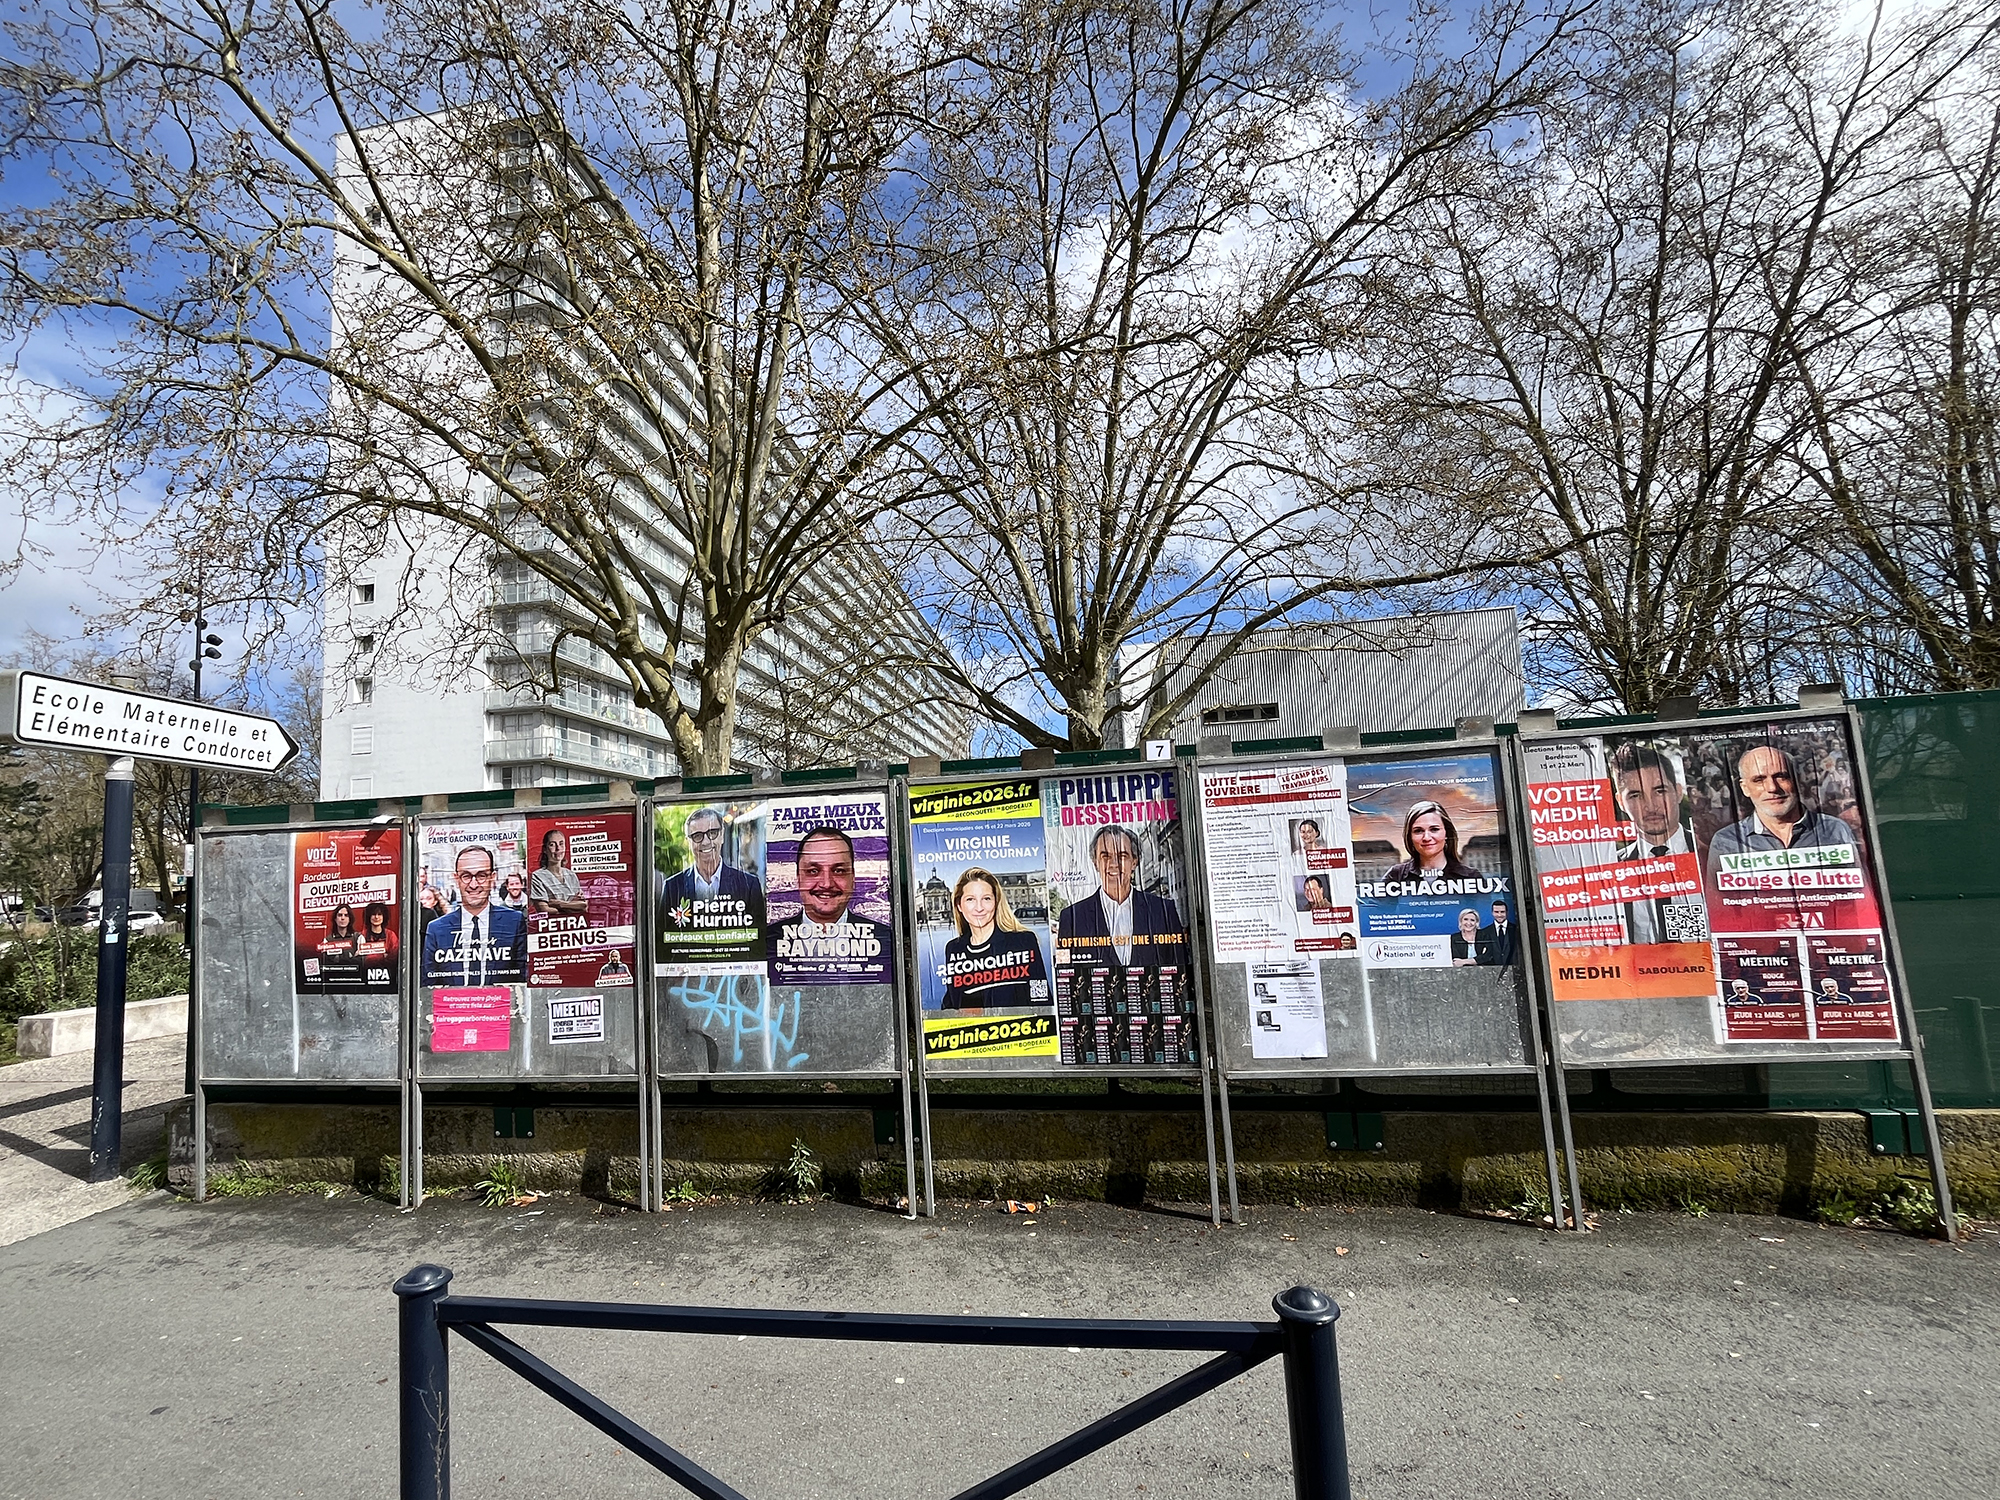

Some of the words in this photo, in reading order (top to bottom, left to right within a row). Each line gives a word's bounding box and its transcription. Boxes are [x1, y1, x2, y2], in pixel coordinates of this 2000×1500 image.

[32, 685, 104, 714] Ecole
[123, 702, 237, 737] Maternelle
[251, 727, 267, 742] et
[31, 711, 170, 749] Elémentaire
[183, 736, 272, 763] Condorcet
[1694, 734, 1727, 742] ÉLECTIONS
[1155, 745, 1164, 757] 7
[1204, 776, 1236, 788] LUTTE
[1290, 772, 1310, 780] CAMP
[1311, 768, 1324, 776] DES
[1060, 772, 1175, 806] PHILIPPE
[1204, 784, 1260, 797] OUVRIÈRE
[1281, 776, 1329, 791] TRAVAILLEURS
[1528, 784, 1602, 805] VOTEZ
[912, 783, 1032, 814] virginie2026.fr
[1308, 791, 1341, 799] BORDEAUX
[772, 806, 821, 821] FAIRE
[824, 802, 881, 818] MIEUX
[1001, 802, 1033, 812] BORDEAUX
[1061, 799, 1180, 827] DESSERTINE
[1532, 806, 1598, 824] MEDHI
[792, 816, 885, 834] BORDEAUX
[946, 825, 974, 833] municipales
[1533, 822, 1637, 843] Saboulard
[428, 836, 448, 844] FAIRE
[450, 834, 478, 843] GAGNER
[479, 832, 518, 841] BORDEAUX
[572, 834, 606, 842] ARRACHER
[944, 835, 1011, 850] VIRGINIE
[307, 846, 337, 860] VOTEZ
[572, 844, 620, 854] BORDEAUX
[918, 850, 982, 864] BONTHOUX
[984, 846, 1040, 859] TOURNAY
[1308, 852, 1346, 861] QUANDALLE
[1723, 853, 1772, 870] Vert
[1776, 851, 1800, 865] de
[1805, 848, 1850, 865] rage
[303, 872, 340, 882] Bordeaux
[1419, 868, 1444, 878] Julie
[1542, 873, 1582, 888] Pour
[1584, 870, 1613, 882] une
[1615, 860, 1676, 882] gauche
[1720, 872, 1783, 891] Rouge
[1788, 872, 1812, 886] de
[1817, 871, 1861, 885] lutte
[310, 880, 360, 896] OUVRIÈRE
[1359, 877, 1510, 898] RECHAGNEUX
[1546, 894, 1564, 908] Ni
[1568, 892, 1591, 906] PS
[1601, 888, 1619, 901] Ni
[1620, 880, 1696, 898] Extrême
[305, 890, 388, 908] RÉVOLUTIONNAIRE
[692, 899, 746, 914] Pierre
[1723, 898, 1752, 906] Rouge
[1800, 892, 1865, 903] Anticapitaliste
[538, 916, 588, 932] PETRA
[694, 912, 754, 928] Hurmic
[1544, 914, 1625, 924] MEDHISABOULARD.FR
[665, 932, 703, 942] Bordeaux
[716, 930, 757, 940] confiance
[782, 922, 875, 940] NORDINE
[451, 931, 497, 948] Thomas
[538, 930, 608, 950] BERNUS
[1056, 936, 1111, 948] L'OPTIMISME
[1114, 936, 1130, 946] EST
[1132, 934, 1150, 945] UNE
[1154, 934, 1182, 944] FORCE
[434, 946, 512, 962] CAZENAVE
[776, 939, 881, 957] RAYMOND
[956, 952, 966, 960] LA
[1420, 951, 1435, 959] udr
[1740, 956, 1788, 967] MEETING
[1828, 955, 1876, 965] MEETING
[368, 968, 390, 980] NPA
[942, 976, 952, 986] DE
[954, 964, 1030, 988] BORDEAUX
[1559, 966, 1621, 980] MEDHI
[1638, 965, 1706, 975] SABOULARD
[552, 1000, 600, 1018] MEETING
[436, 1014, 508, 1024] fairegagnerbordeaux.fr
[928, 1018, 1050, 1050] virginie2026.fr
[1018, 1038, 1051, 1048] BORDEAUX
